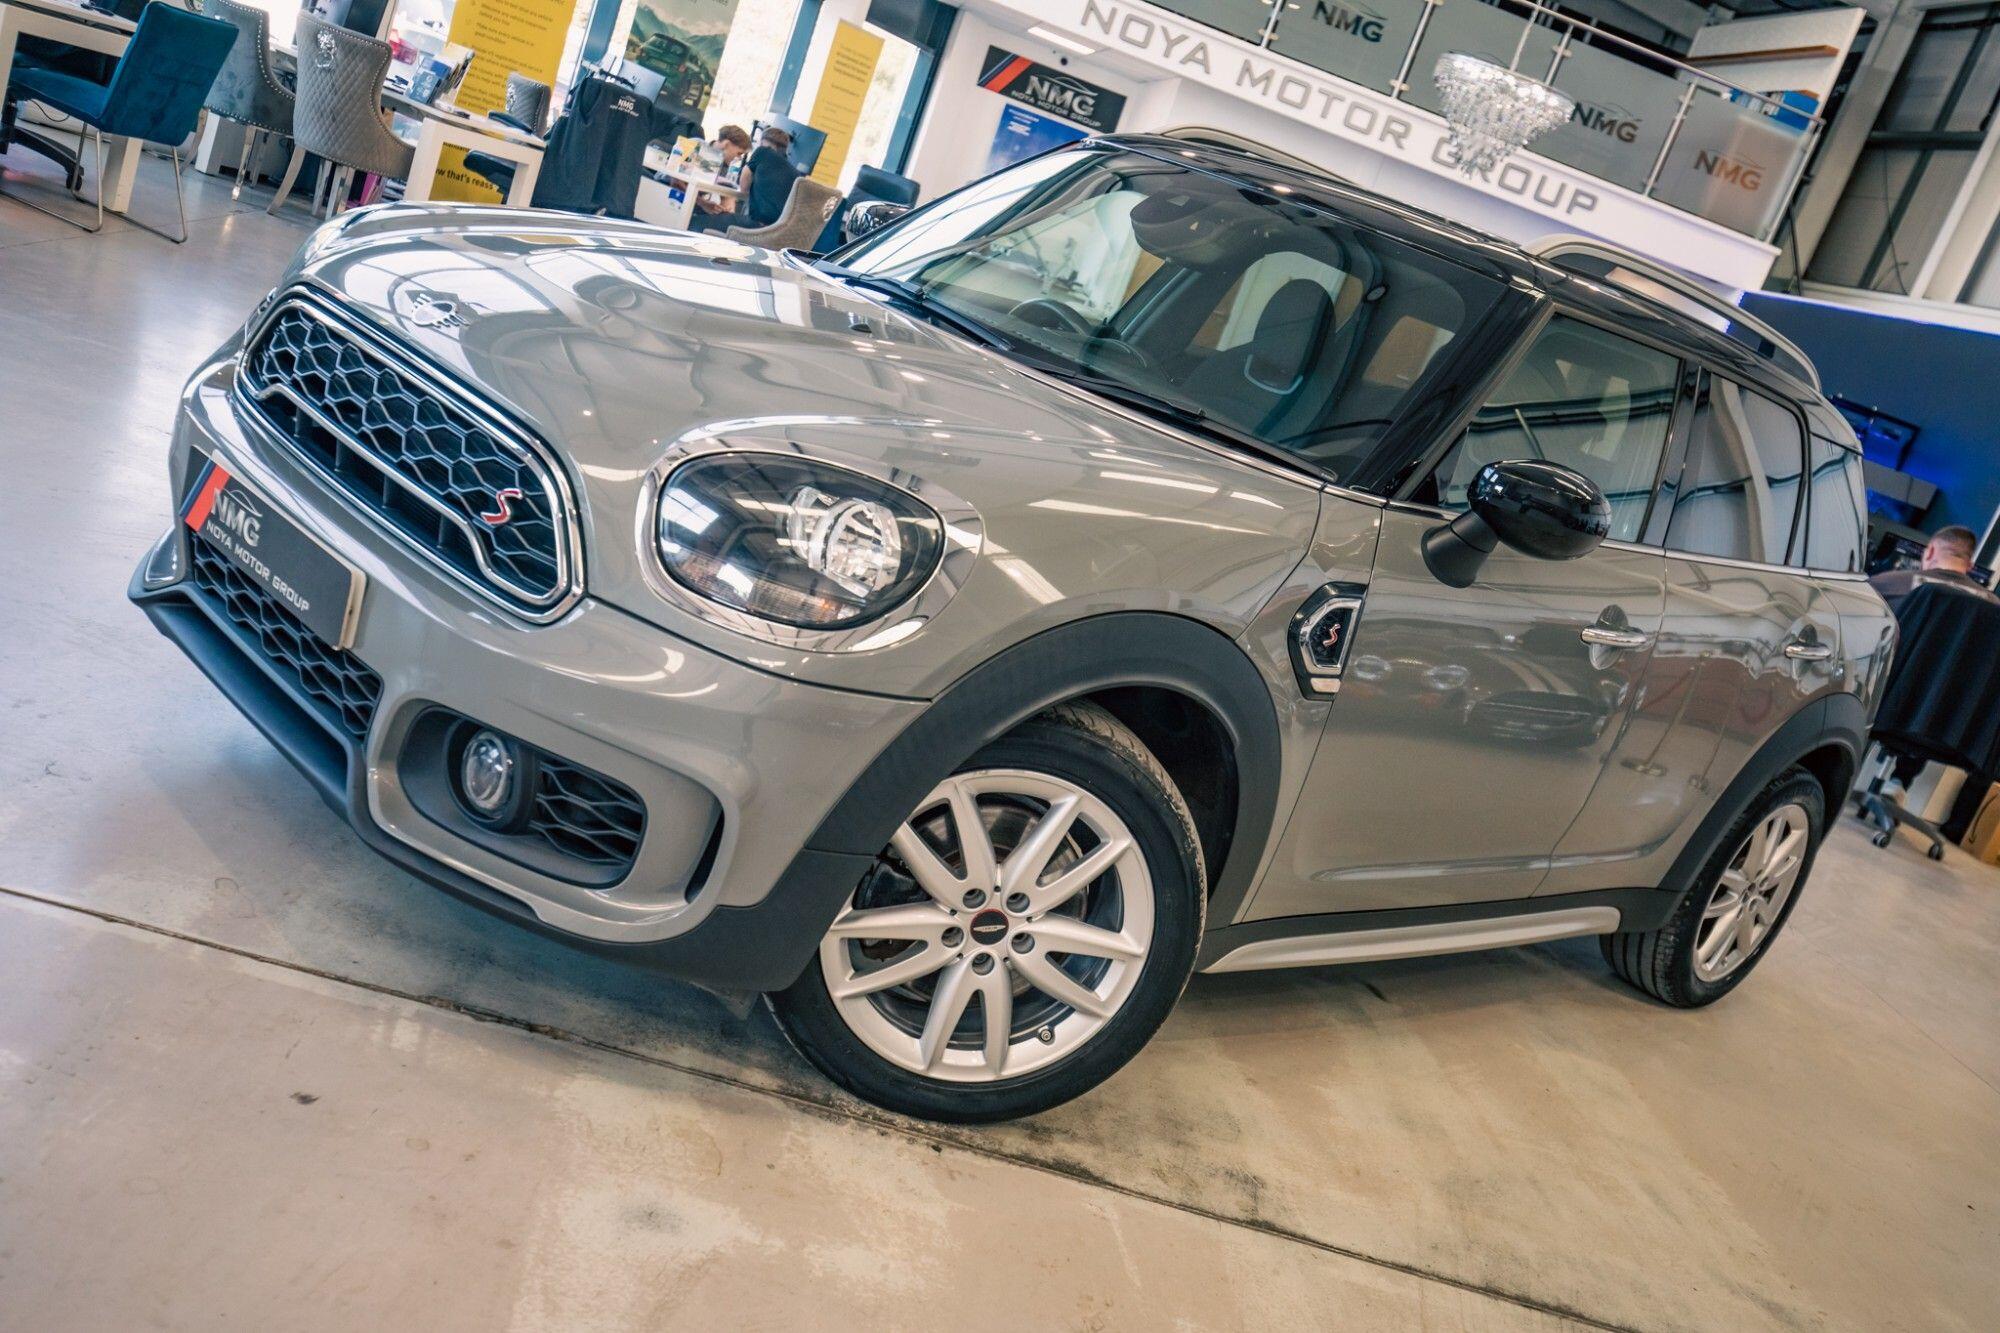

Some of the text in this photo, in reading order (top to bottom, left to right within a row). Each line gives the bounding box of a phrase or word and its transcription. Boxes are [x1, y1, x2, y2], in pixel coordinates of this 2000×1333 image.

[1312, 0, 1384, 43] NMG
[1025, 74, 1096, 116] NMG
[1080, 0, 1212, 75] NOYA
[1236, 58, 1413, 150] MOTOR
[1011, 90, 1035, 104] NOYA
[1037, 100, 1069, 116] MOTOR
[1069, 112, 1102, 127] GROUP
[1569, 101, 1639, 143] NMG
[447, 168, 470, 184] that's
[1693, 149, 1761, 191] NMG
[210, 487, 262, 547] NMG
[481, 487, 523, 526] S
[206, 519, 310, 612] NOYA MOTOR GROUP
[1322, 623, 1341, 648] S
